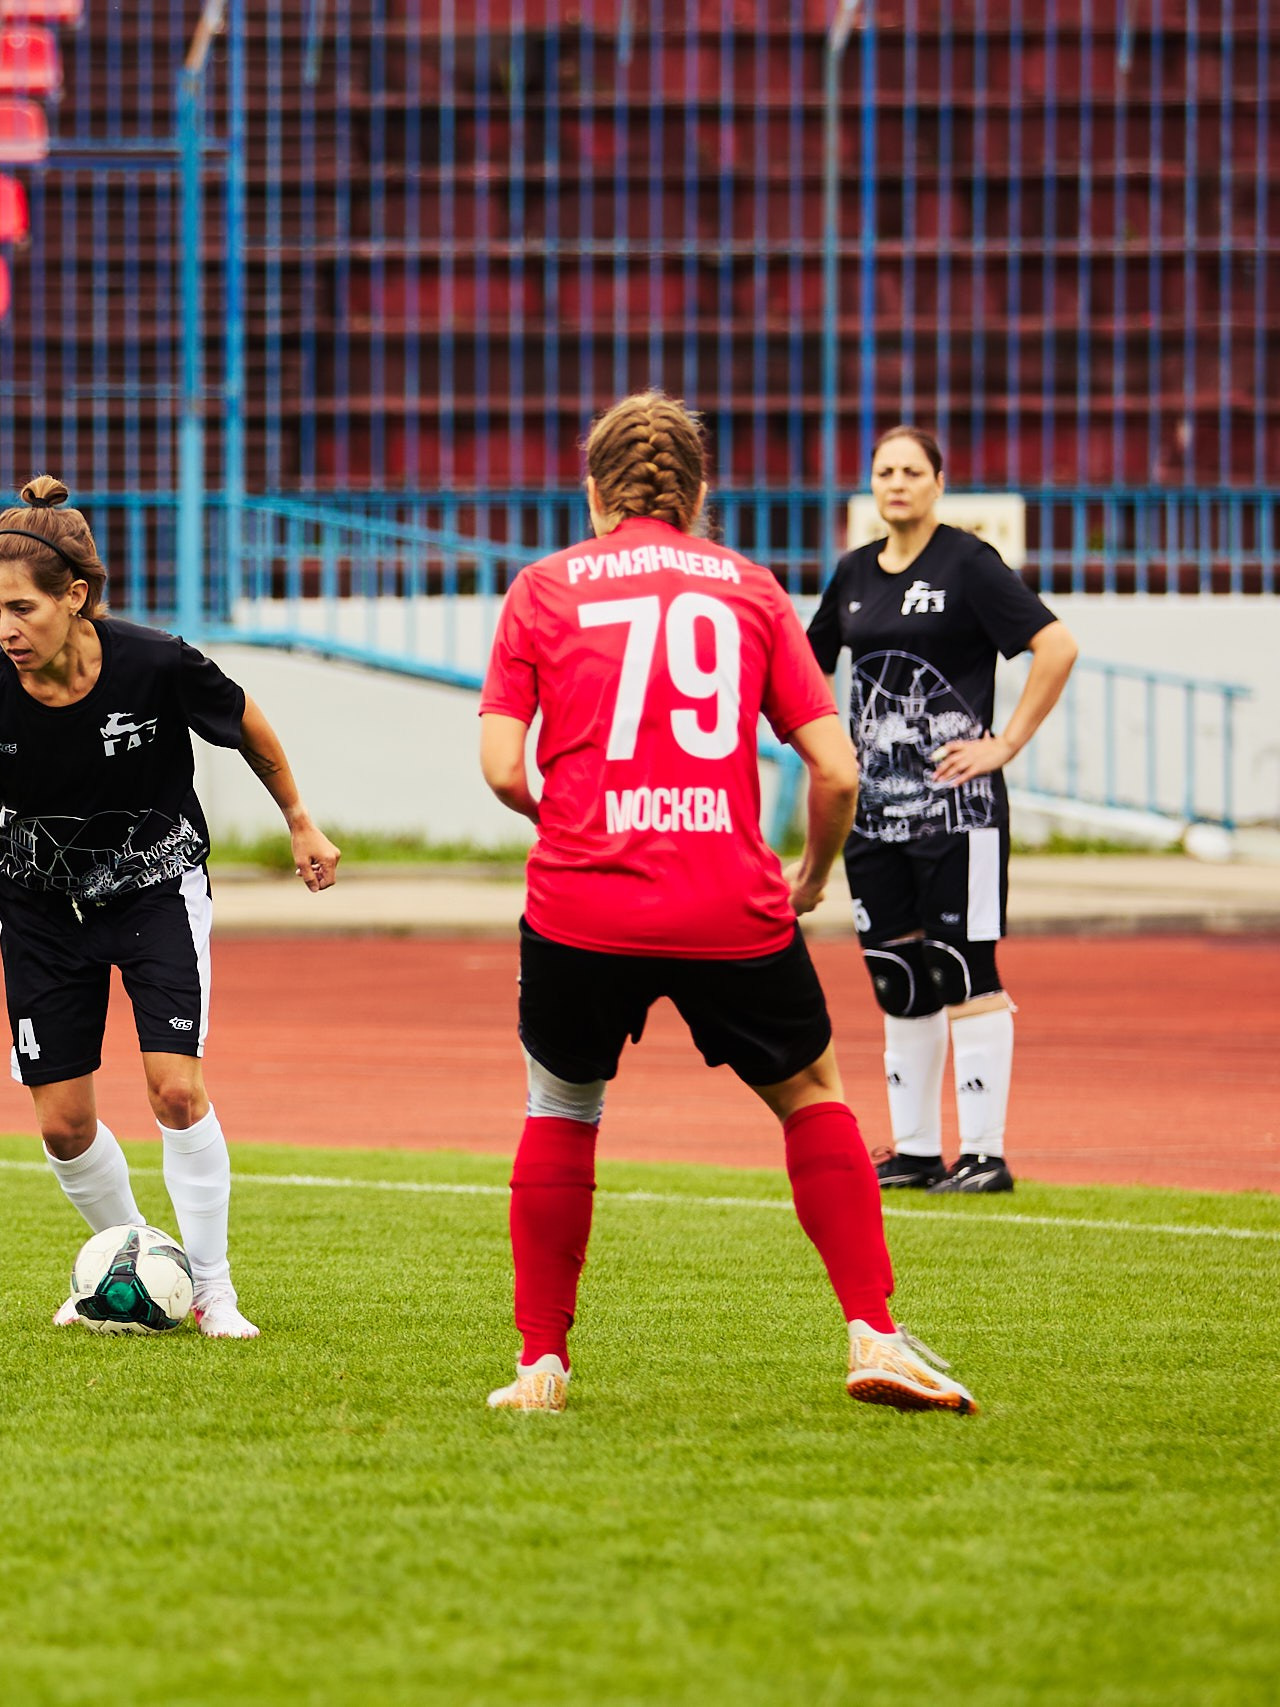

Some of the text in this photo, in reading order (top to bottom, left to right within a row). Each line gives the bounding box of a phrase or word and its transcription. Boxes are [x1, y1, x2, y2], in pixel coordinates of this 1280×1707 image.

[567, 545, 740, 584] РУМЯНЦЕВА
[577, 592, 740, 760] 79
[606, 787, 731, 833] МОСКВА
[19, 1018, 40, 1060] 4
